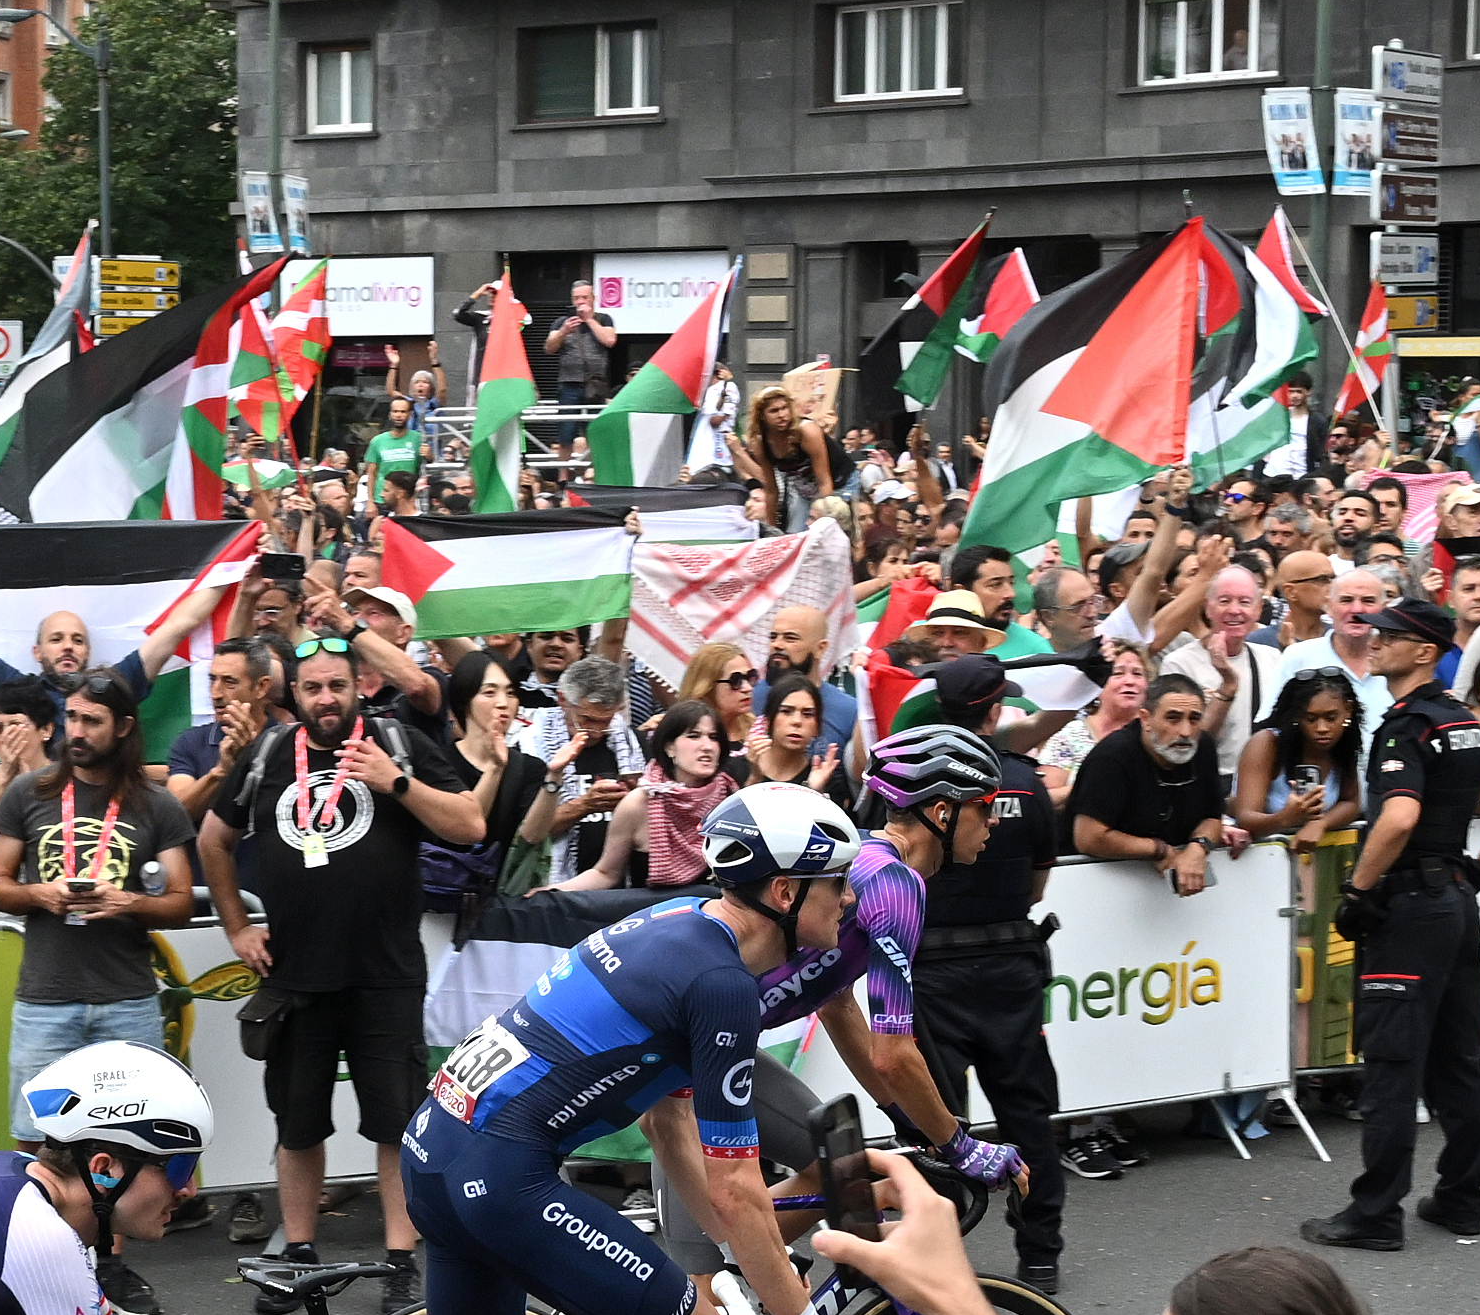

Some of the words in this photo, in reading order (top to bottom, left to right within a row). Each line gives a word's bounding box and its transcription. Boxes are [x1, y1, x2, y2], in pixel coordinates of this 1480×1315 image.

[323, 284, 422, 307] amaliving
[627, 277, 723, 299] famalivin
[947, 761, 988, 782] GIANT
[1042, 940, 1221, 1025] nergía
[874, 1013, 914, 1026] CADE
[93, 1070, 126, 1083] ISRAEL
[546, 1097, 577, 1129] FDJ
[571, 1064, 641, 1109] UNITED
[541, 1202, 655, 1282] Groupama
